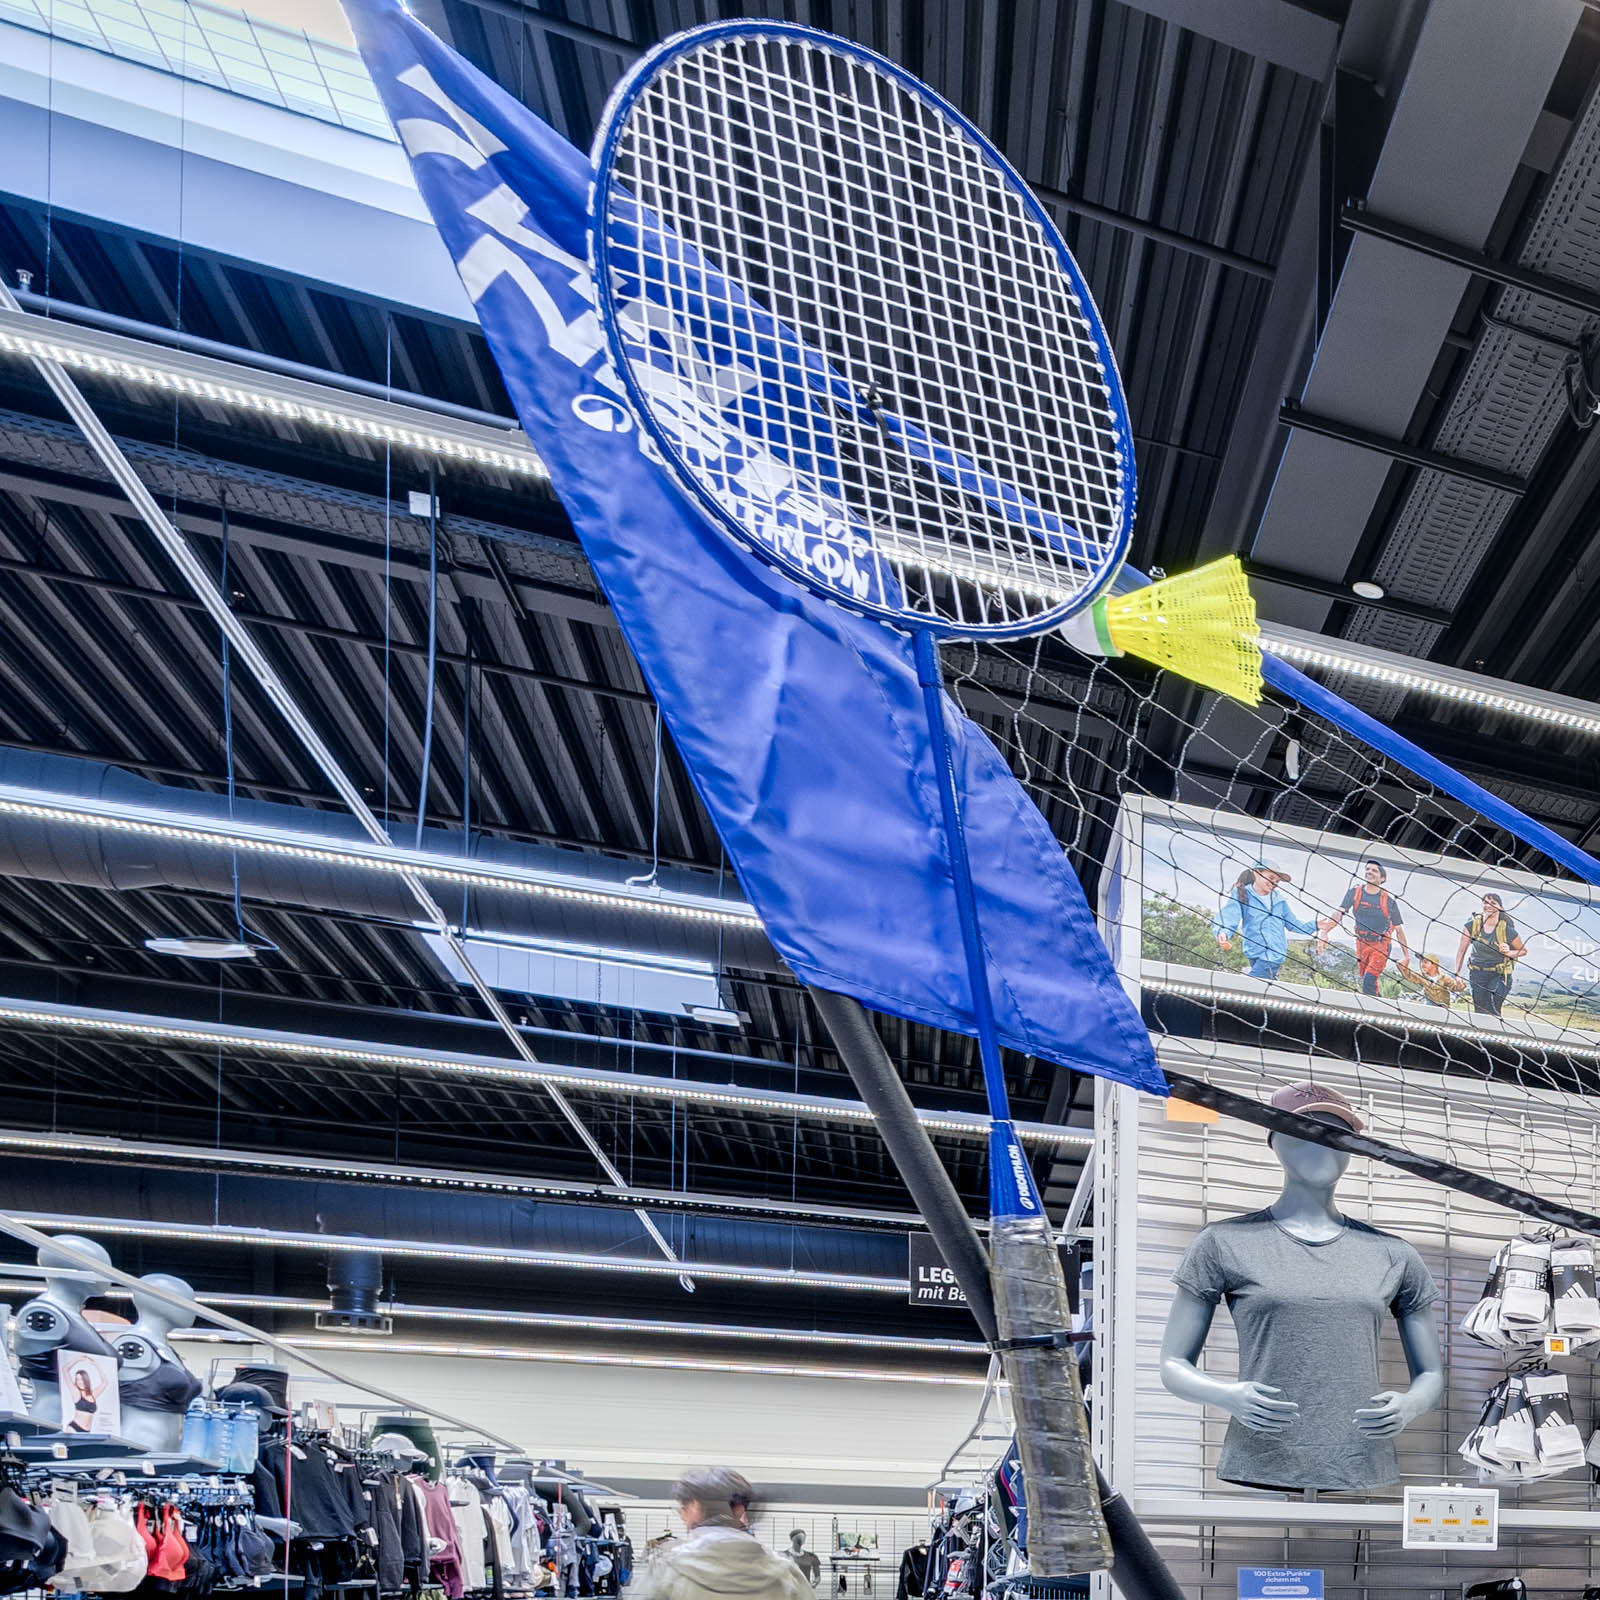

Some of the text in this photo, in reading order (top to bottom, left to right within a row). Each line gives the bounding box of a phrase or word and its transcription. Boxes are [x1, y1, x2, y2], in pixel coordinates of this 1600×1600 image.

[1543, 931, 1594, 952] Dein
[1007, 1144, 1030, 1198] DECATHLON
[918, 1266, 960, 1284] LEG
[917, 1286, 968, 1302] mit Ba
